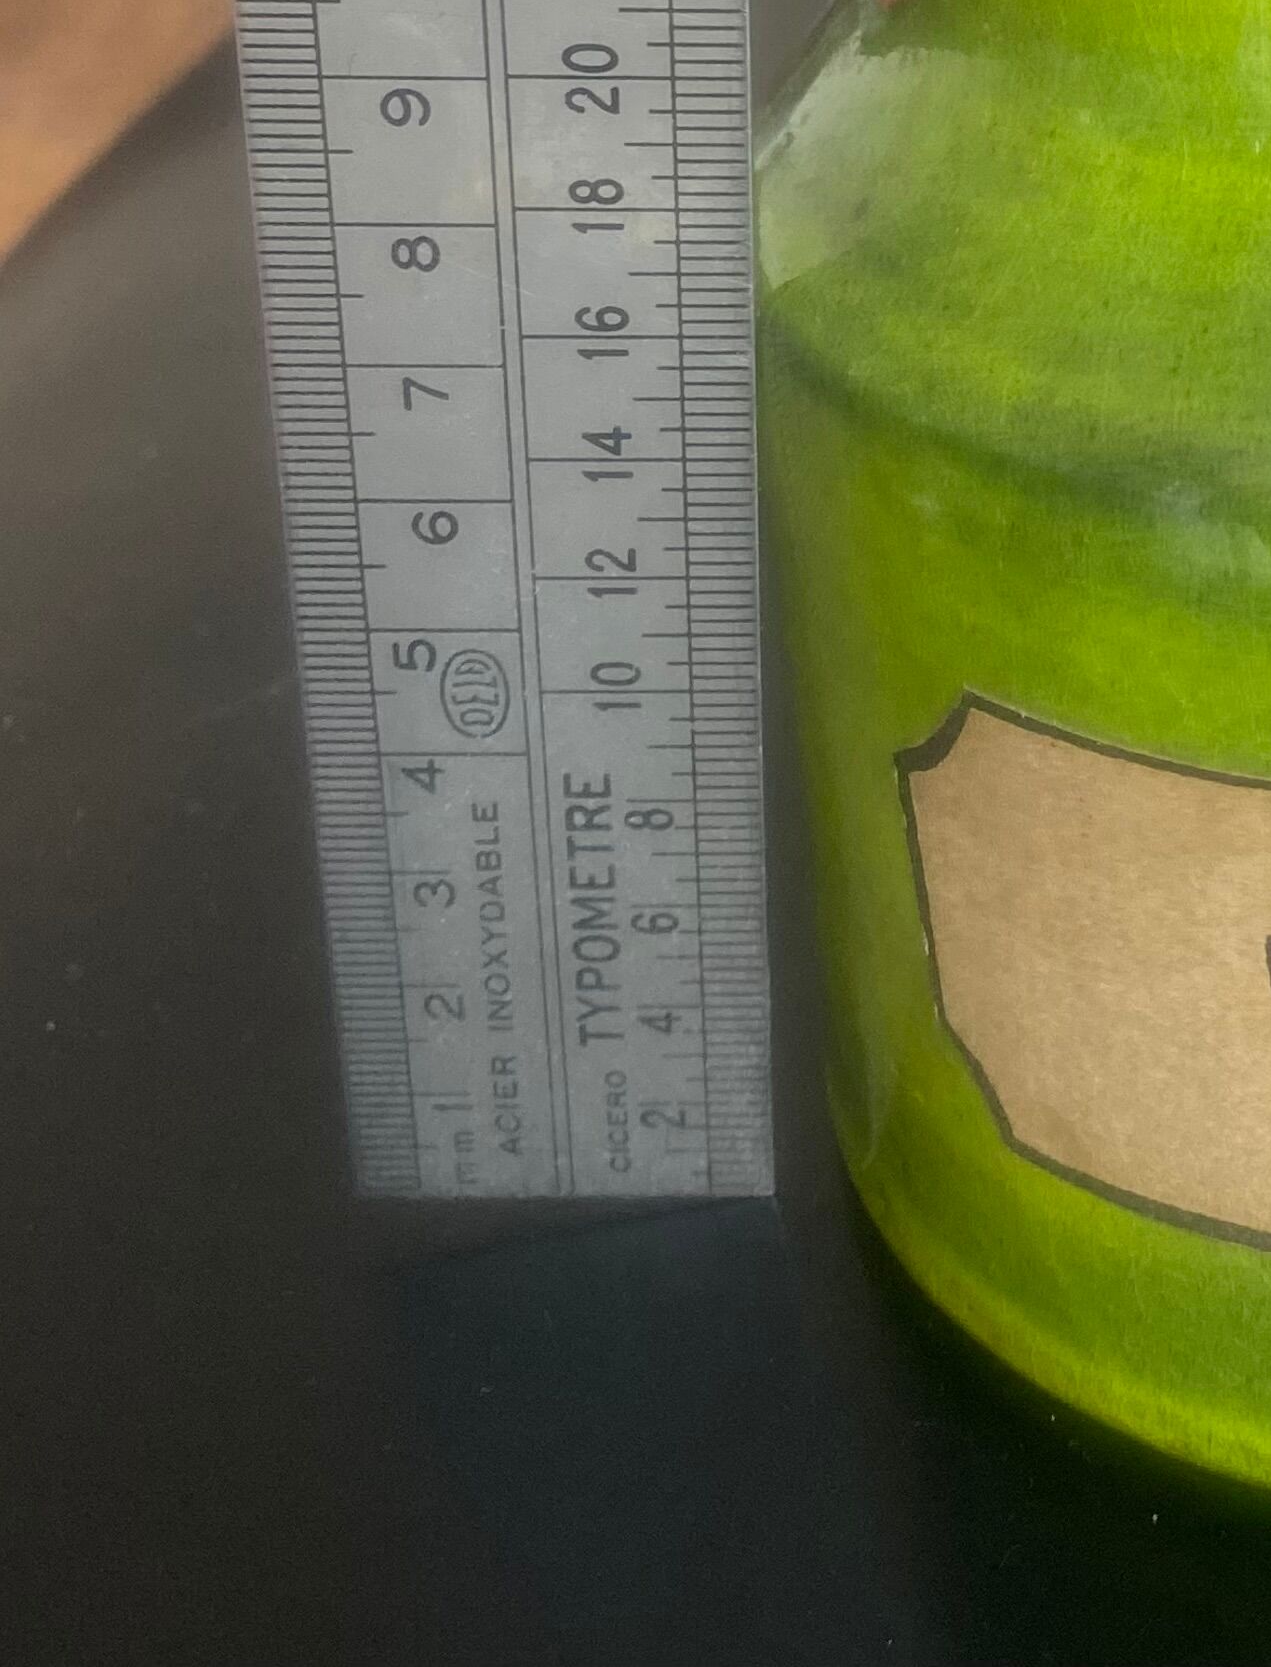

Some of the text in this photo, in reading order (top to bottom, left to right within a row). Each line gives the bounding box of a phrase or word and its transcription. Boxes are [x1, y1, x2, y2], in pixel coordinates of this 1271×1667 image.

[561, 43, 620, 114] 20
[380, 87, 431, 127] 9
[568, 177, 625, 234] 18
[391, 235, 441, 273] 8
[575, 305, 630, 360] 16
[403, 376, 449, 411] 7
[581, 425, 634, 482] 14
[411, 510, 459, 546] 6
[585, 547, 638, 599] 12
[392, 638, 437, 672] 5
[590, 662, 642, 712] 10
[401, 758, 444, 794] 4
[623, 807, 674, 831] 8
[413, 878, 456, 908] 3
[562, 772, 625, 1047] TYPOMETRE
[631, 912, 679, 935] 6
[472, 801, 523, 1157] ACIER INOXYDABLE
[424, 993, 466, 1022] 2
[637, 1010, 682, 1036] 4
[431, 1102, 474, 1112] 1
[604, 1070, 631, 1174] CICERO
[639, 1108, 686, 1129] 2
